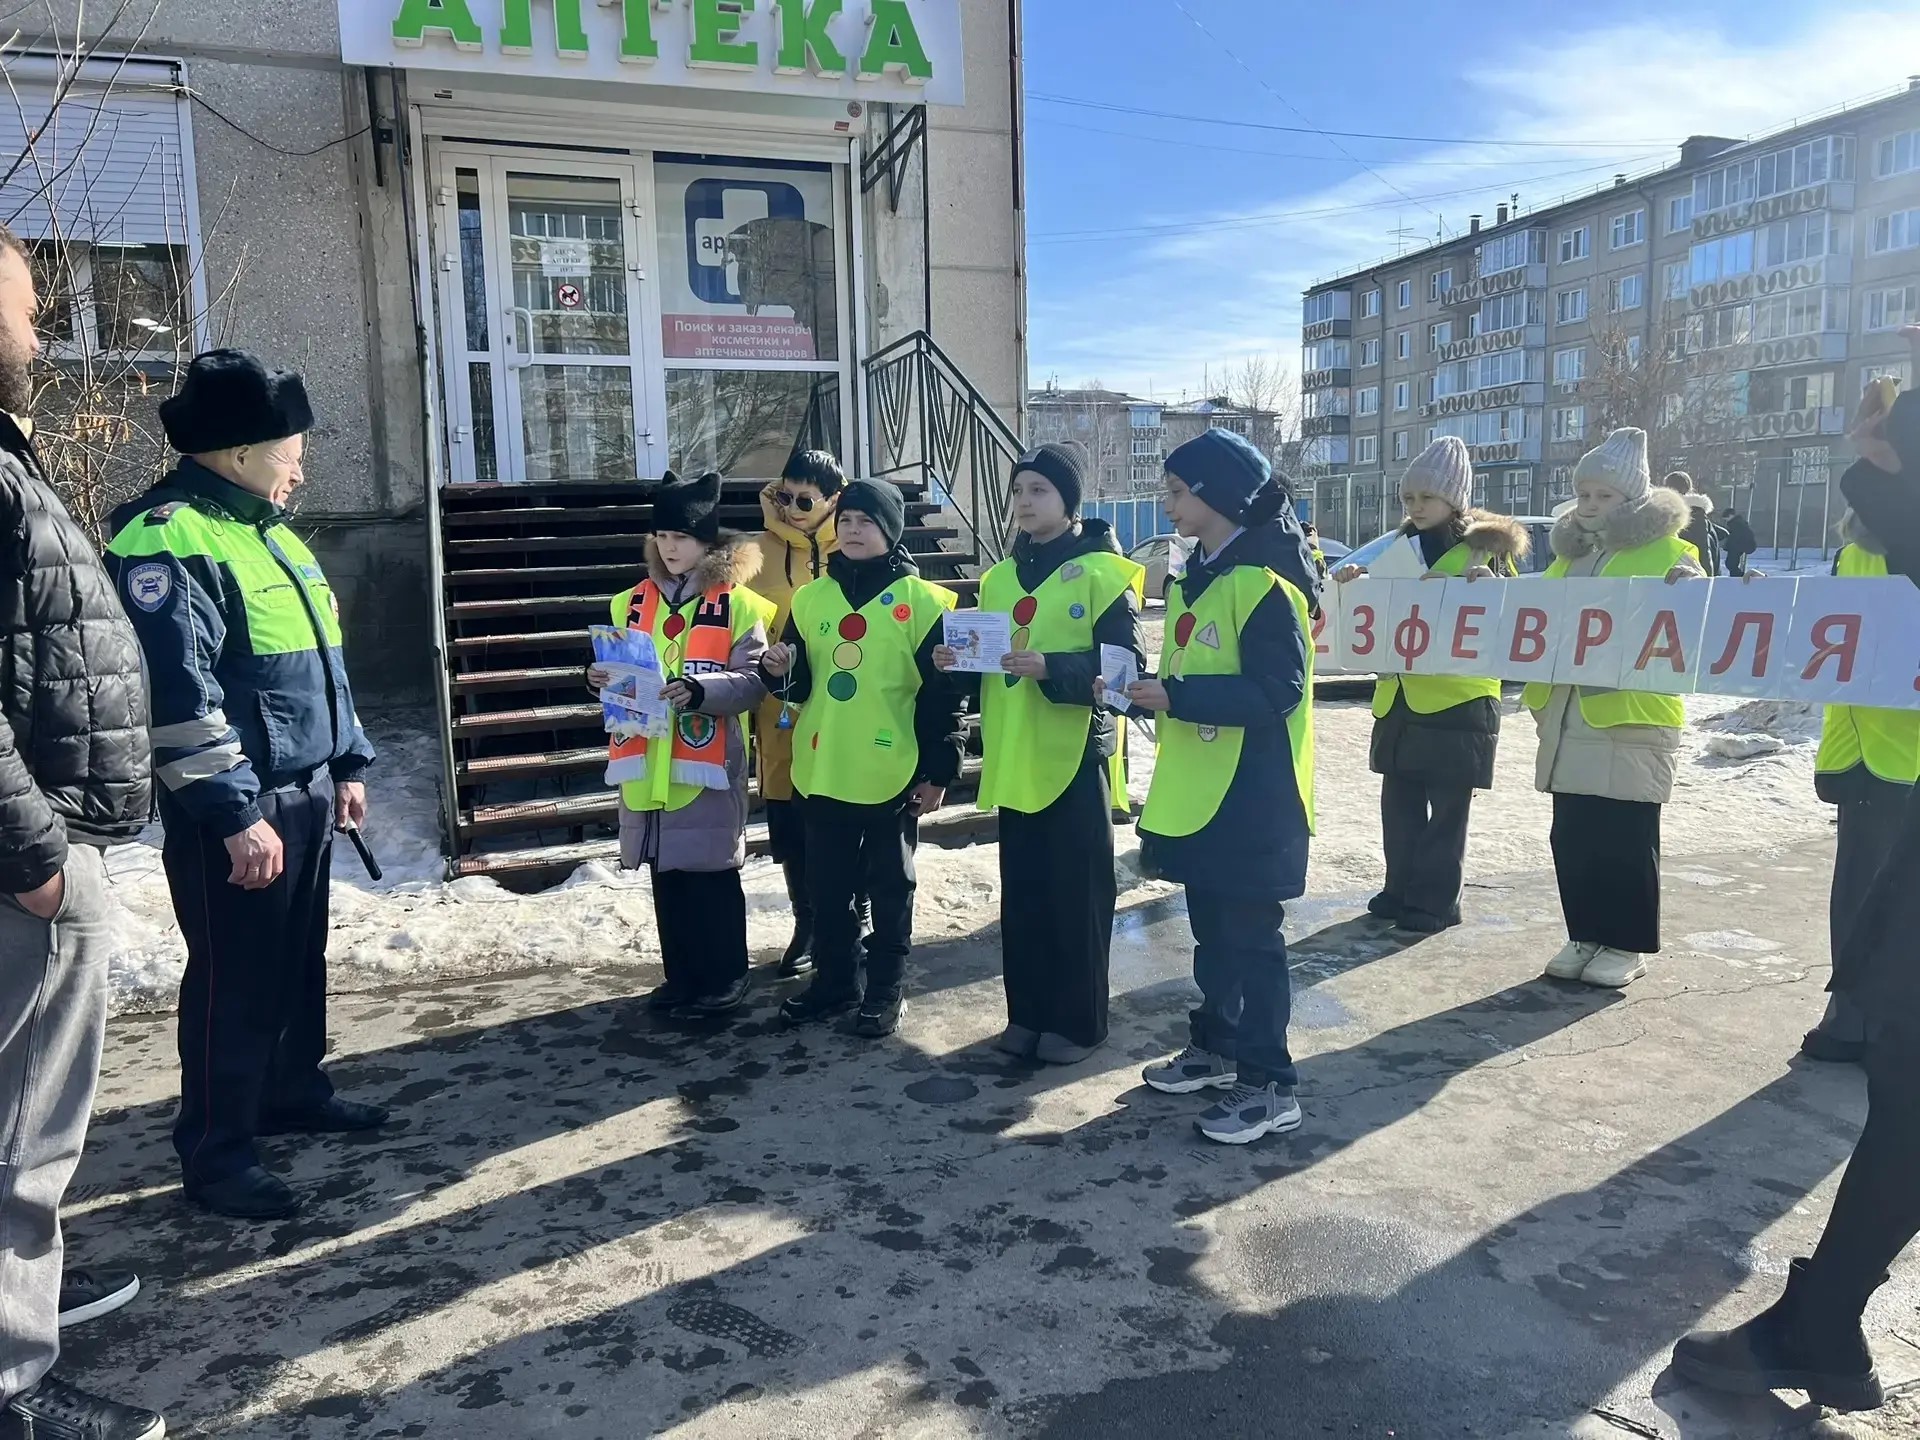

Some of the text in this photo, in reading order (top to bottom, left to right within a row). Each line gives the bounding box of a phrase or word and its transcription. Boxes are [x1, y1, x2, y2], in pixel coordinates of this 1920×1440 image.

[391, 0, 933, 80] АПТЕКА
[674, 320, 714, 332] Поиск
[728, 325, 763, 334] заказ
[711, 335, 791, 346] косметики и
[694, 346, 808, 360] аптечных товаров
